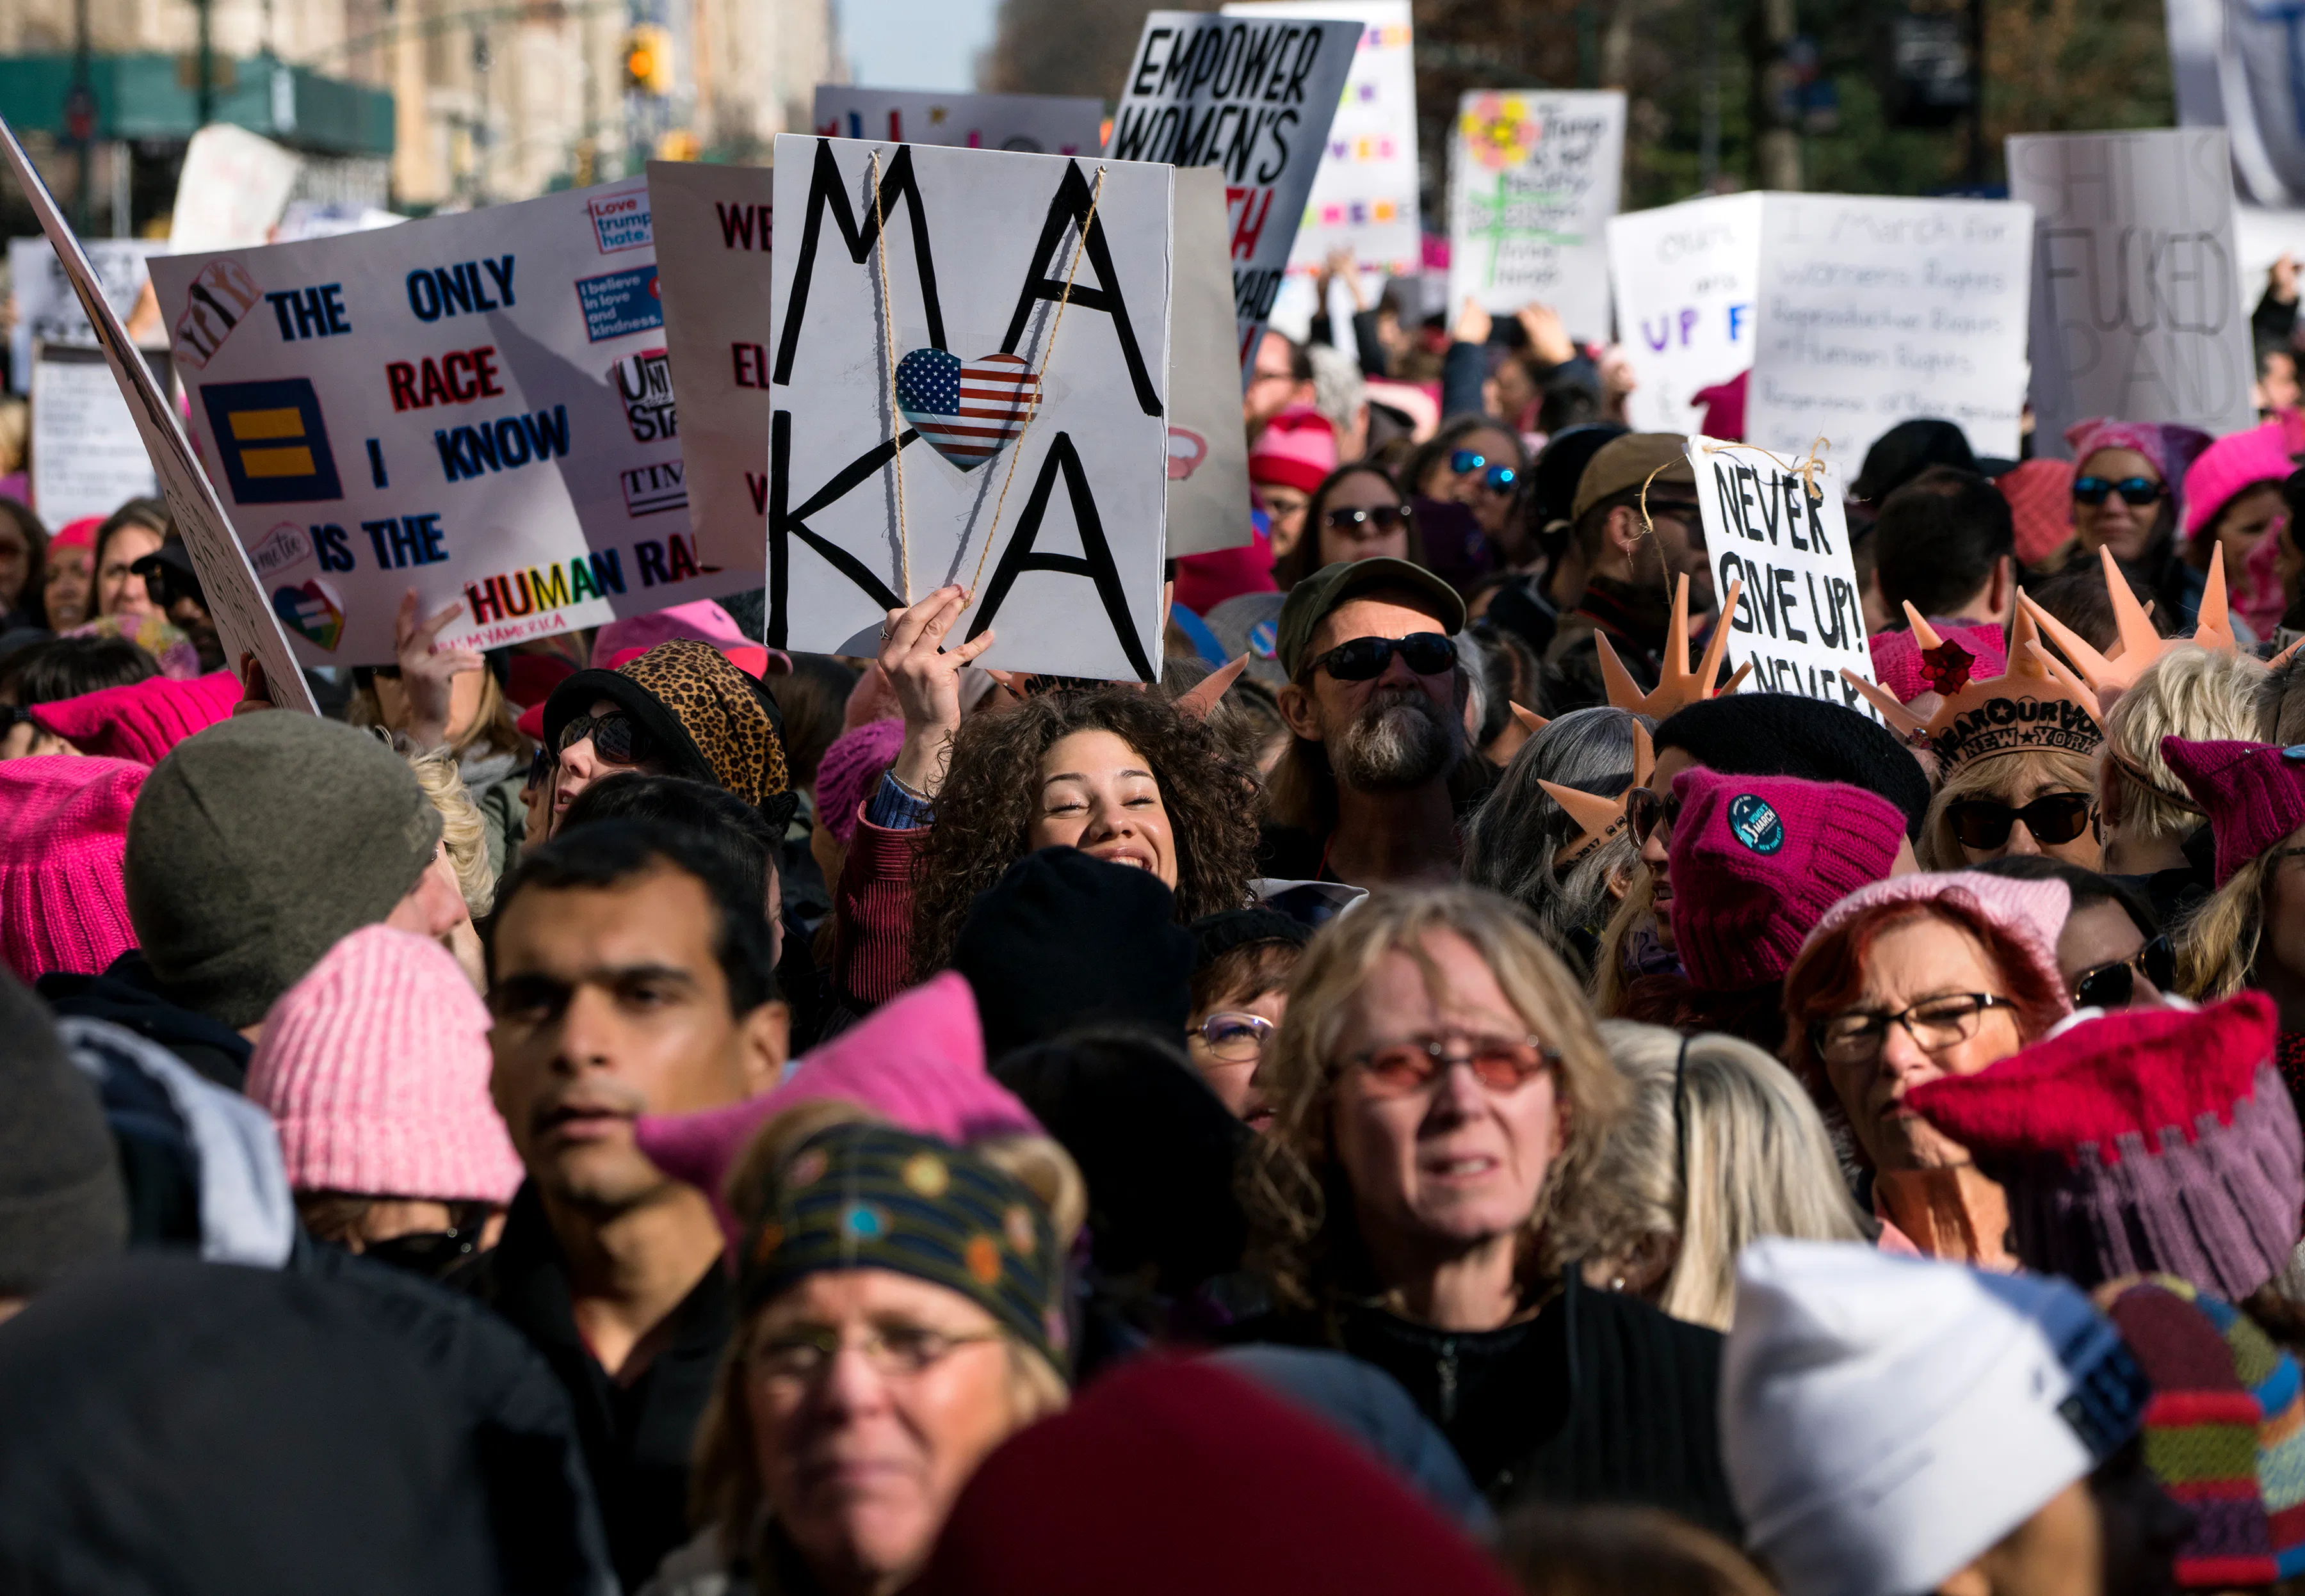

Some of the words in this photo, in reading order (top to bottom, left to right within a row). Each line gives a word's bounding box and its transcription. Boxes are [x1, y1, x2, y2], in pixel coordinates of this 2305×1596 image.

[1133, 22, 1323, 104] EMPOWER
[1115, 105, 1300, 184] WOMEN'S
[595, 197, 637, 216] Love
[597, 211, 652, 232] trump
[602, 229, 651, 248] hate.
[264, 282, 352, 342] THE
[406, 254, 516, 322] ONLY
[588, 275, 640, 296] believe
[583, 296, 599, 311] in
[599, 291, 631, 307] love
[588, 305, 617, 324] and
[590, 314, 662, 338] kindness.
[1640, 306, 1700, 352] UP
[385, 346, 505, 413] RACE
[366, 438, 389, 489] I
[434, 404, 571, 483] KNOW
[1714, 461, 1832, 555] NEVER
[309, 523, 356, 573] IS
[362, 513, 451, 571] THE
[465, 547, 627, 626] HUMAN
[634, 531, 699, 588] RA
[1720, 551, 1808, 644] GIVE
[1806, 570, 1863, 653] UP!
[1987, 698, 2058, 725] OUR
[2059, 699, 2105, 743] VO
[1966, 728, 2017, 757] NEW
[2035, 727, 2099, 755] YORK
[1749, 803, 1768, 824] WOMEN'S
[1753, 809, 1776, 834] MARCH
[1576, 837, 1600, 857] 2017
[1770, 837, 1780, 849] YORK
